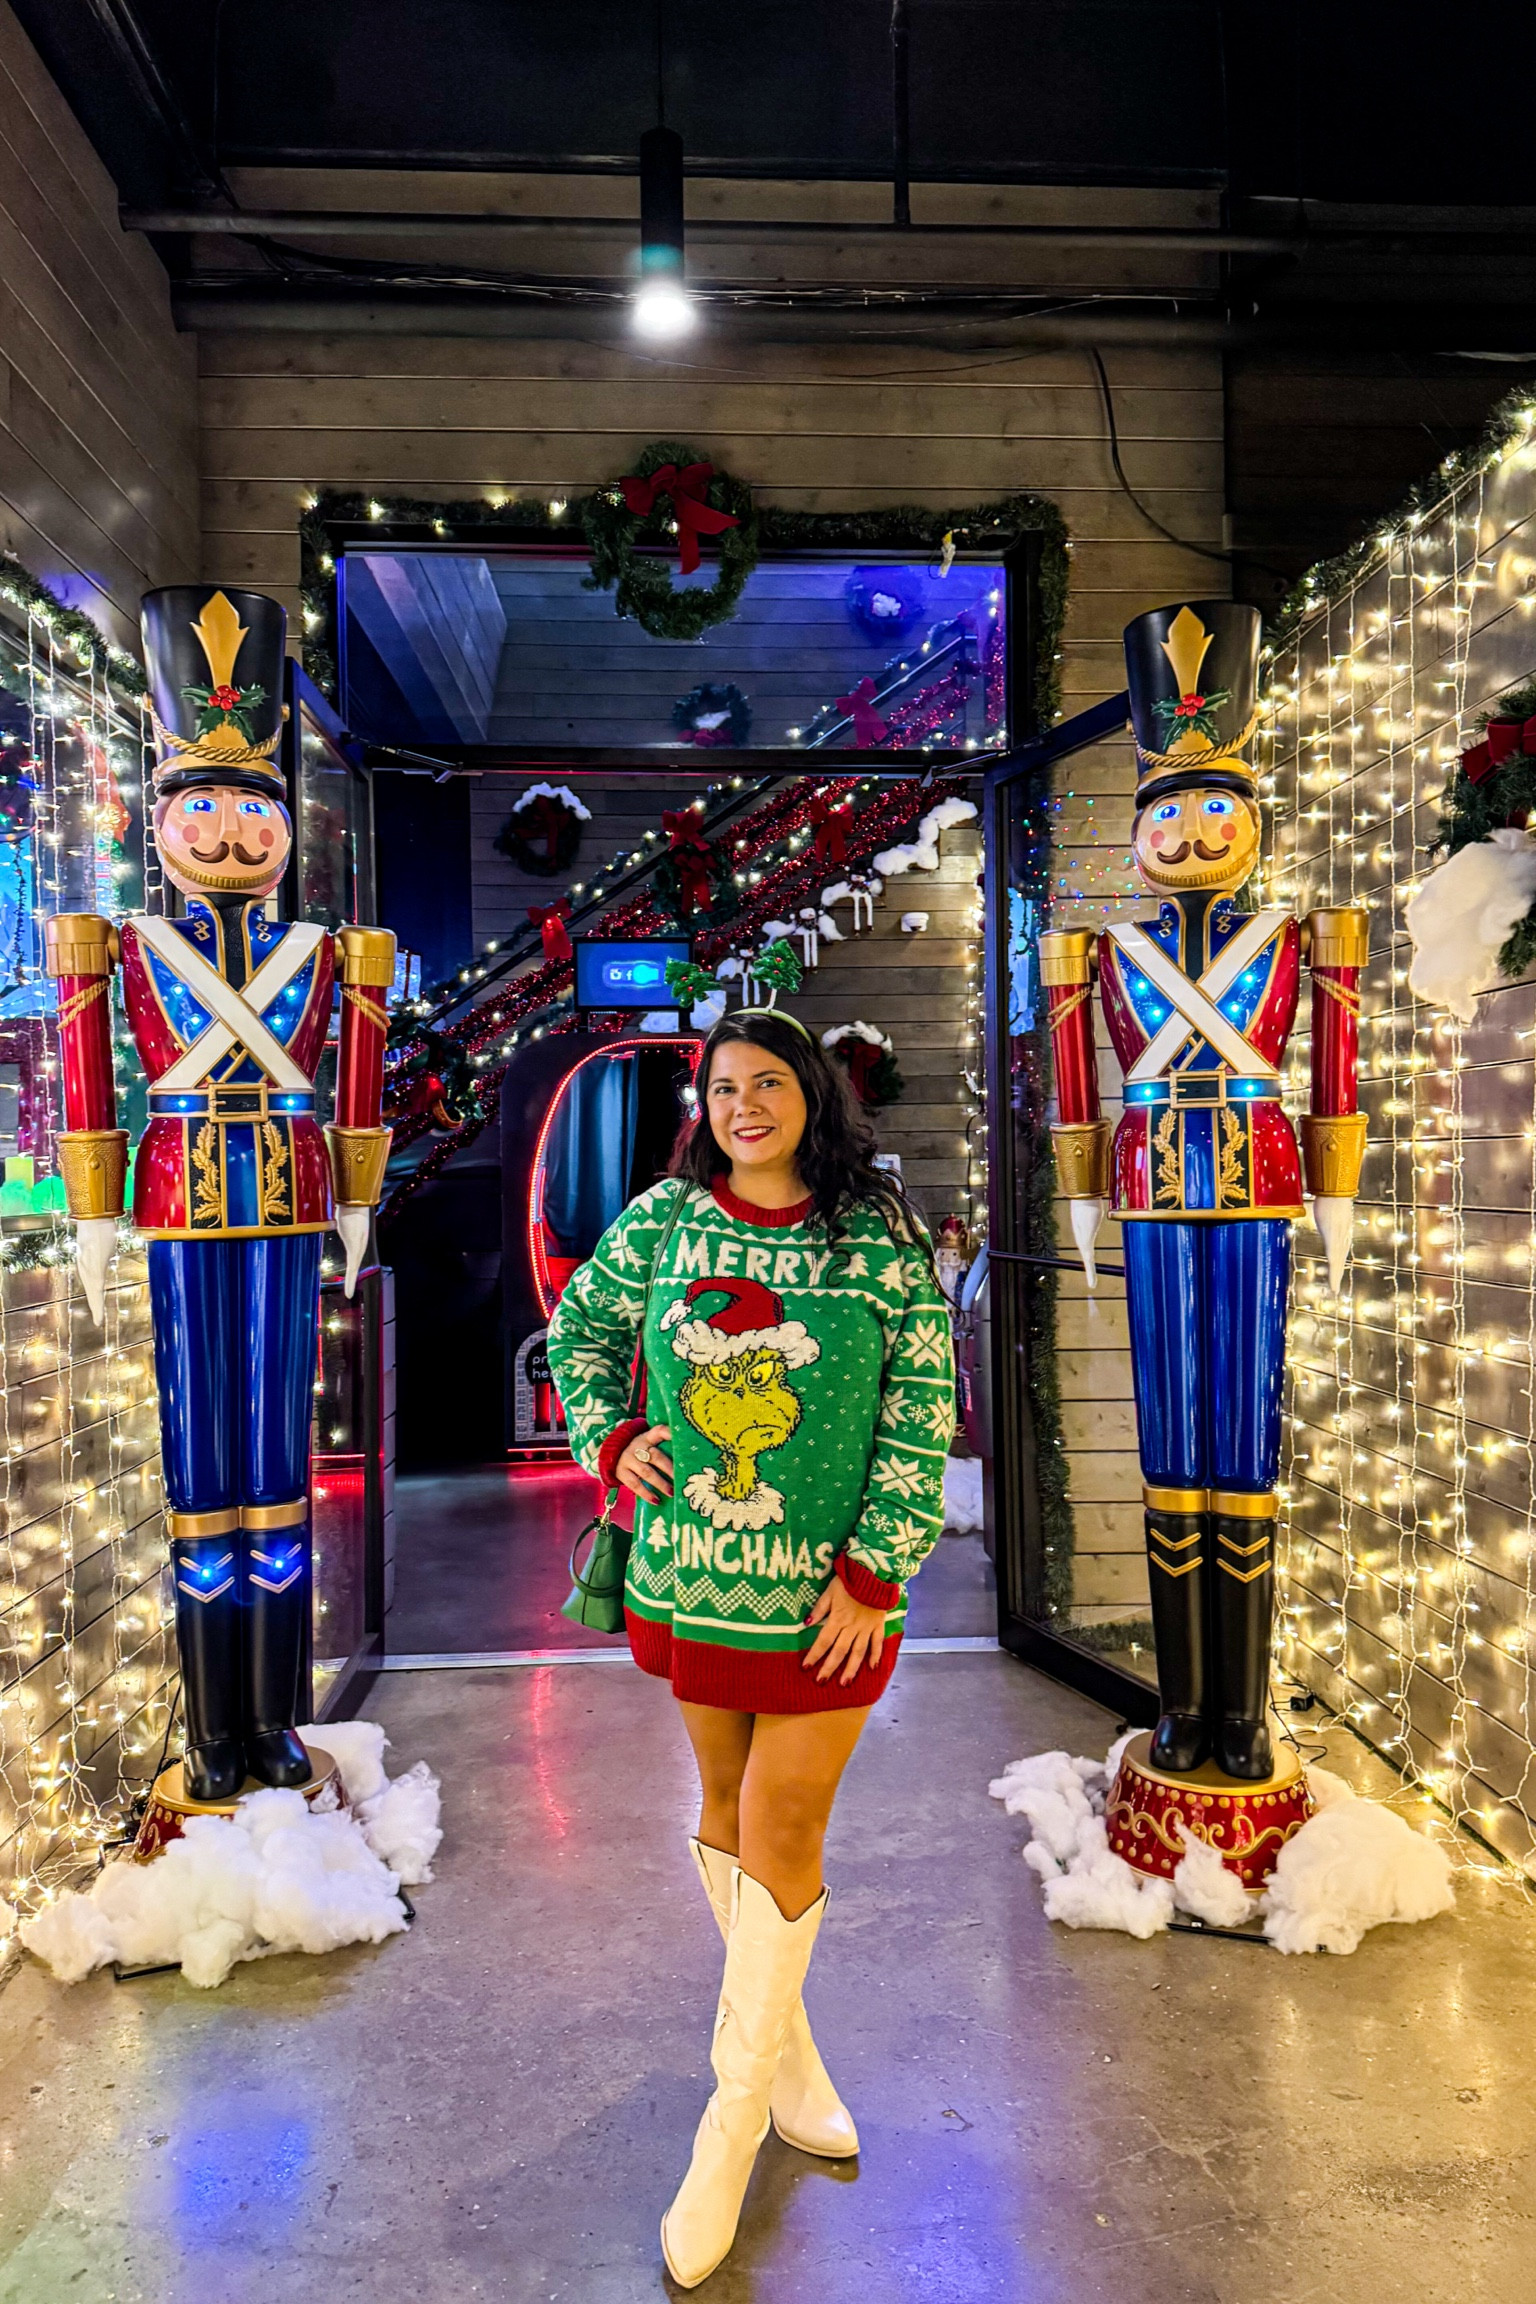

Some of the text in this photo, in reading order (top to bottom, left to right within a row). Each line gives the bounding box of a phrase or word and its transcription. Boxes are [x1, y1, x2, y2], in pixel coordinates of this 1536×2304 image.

[673, 1229, 833, 1287] MERRY
[532, 1356, 548, 1366] pr
[671, 1523, 834, 1580] INCHMAS
